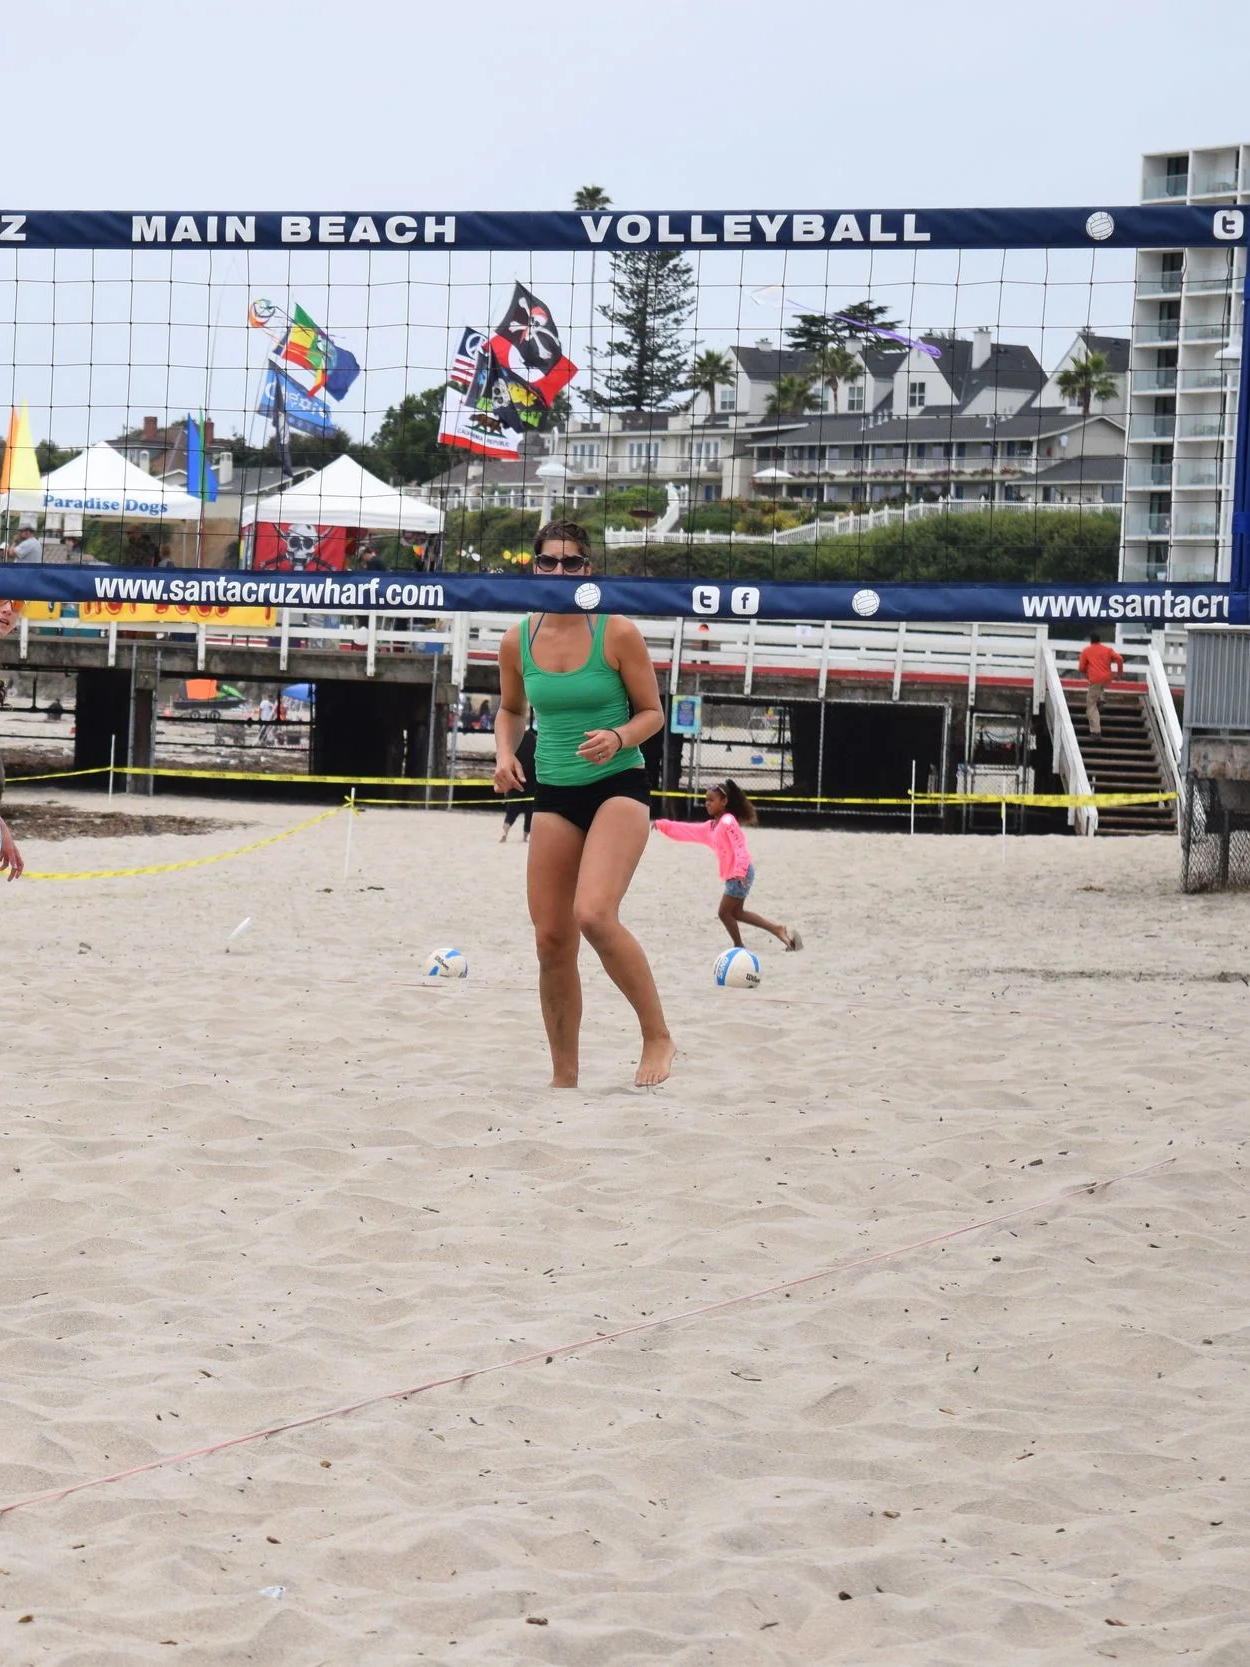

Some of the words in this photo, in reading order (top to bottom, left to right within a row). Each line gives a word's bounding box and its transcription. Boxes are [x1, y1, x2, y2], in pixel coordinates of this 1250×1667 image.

[131, 215, 256, 242] MAIN
[281, 215, 456, 243] BEACH
[581, 213, 931, 243] VOLLEYBALL
[43, 494, 119, 511] Paradise
[126, 498, 168, 515] Dogs
[94, 576, 444, 606] www.santacruzwharf.com
